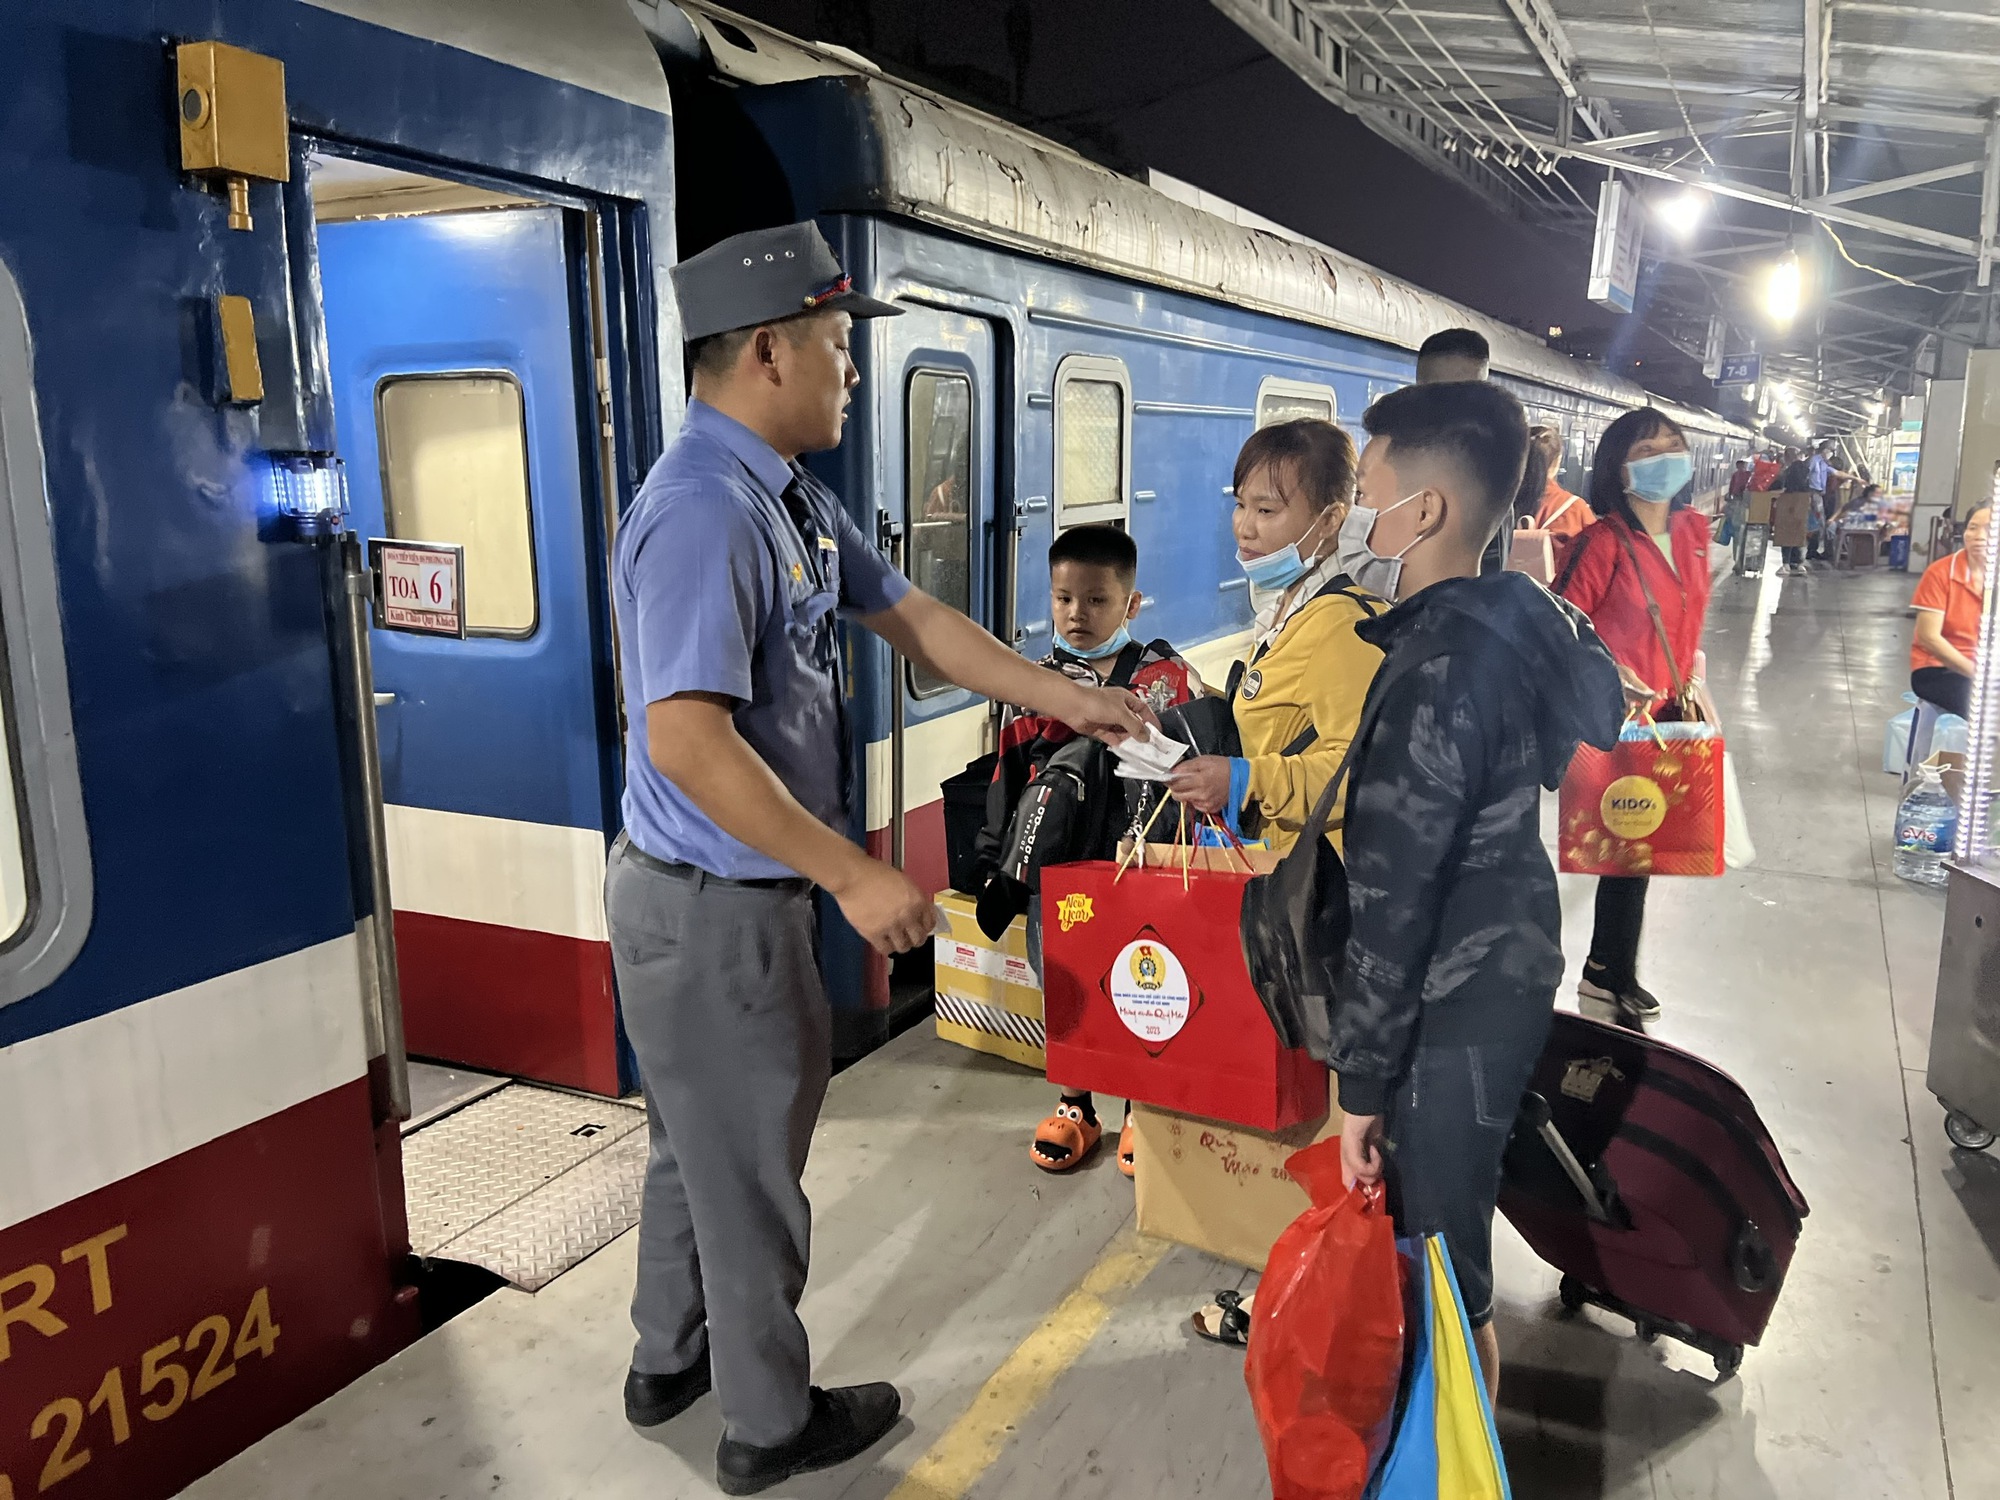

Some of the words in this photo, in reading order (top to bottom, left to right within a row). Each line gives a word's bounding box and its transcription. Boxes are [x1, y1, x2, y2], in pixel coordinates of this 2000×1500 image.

[1726, 365, 1747, 377] 7-8
[389, 576, 419, 599] TOA
[429, 570, 442, 604] 6
[1024, 806, 1045, 864] adidas
[1065, 896, 1085, 908] New
[1061, 909, 1089, 929] Year
[1145, 1025, 1160, 1035] 2023
[30, 1286, 281, 1492] 21524
